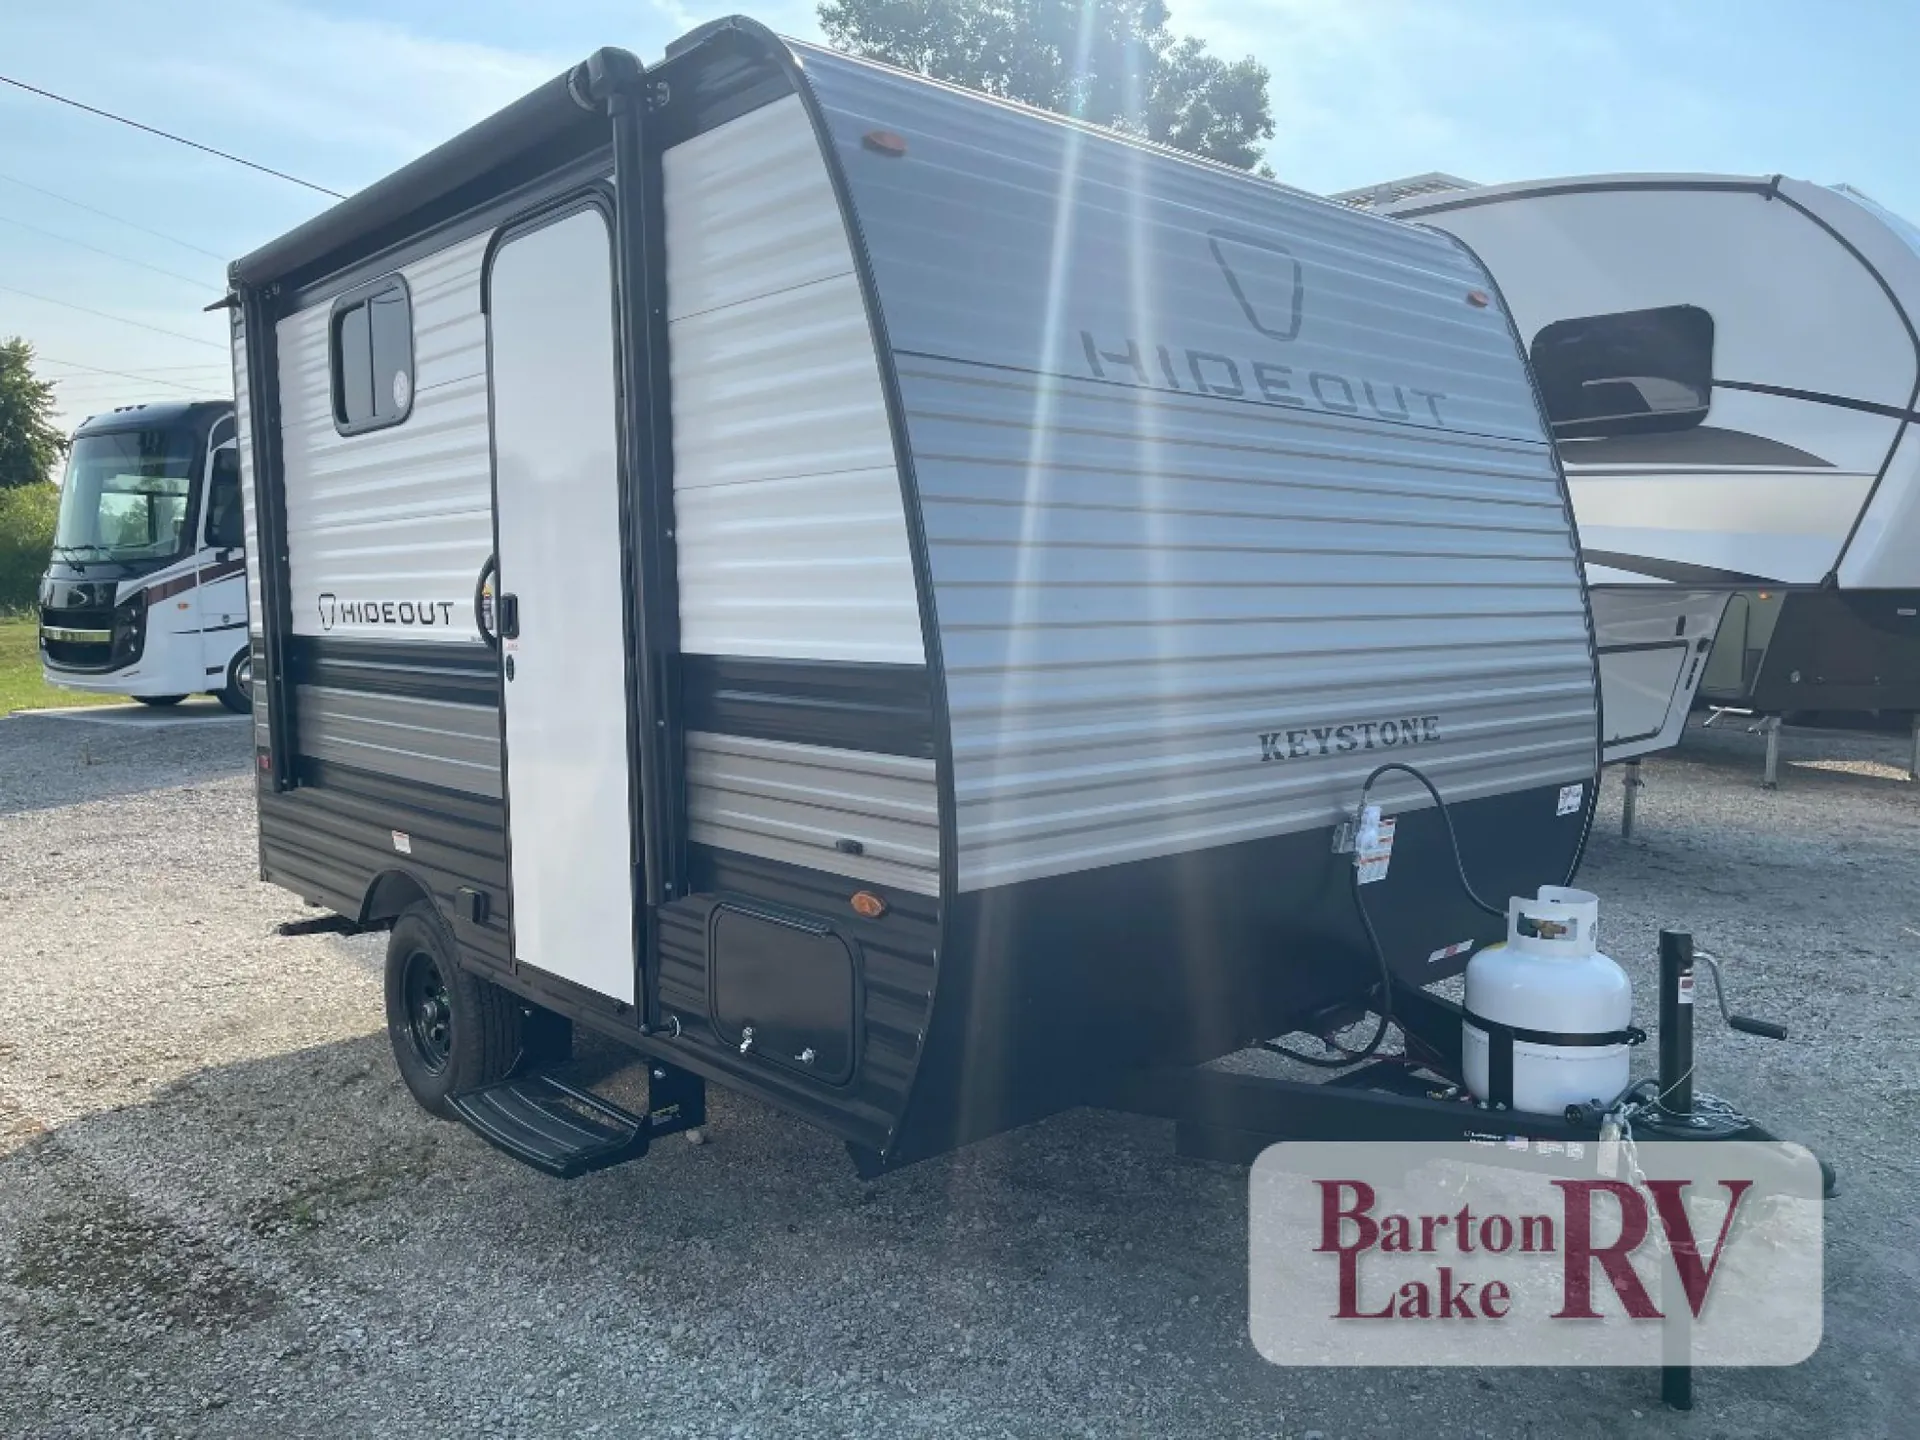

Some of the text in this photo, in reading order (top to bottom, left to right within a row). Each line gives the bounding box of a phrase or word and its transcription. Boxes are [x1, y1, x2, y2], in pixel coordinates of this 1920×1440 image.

[1080, 331, 1446, 425] HIDEOUT
[341, 602, 454, 625] HIDEOUT
[1259, 716, 1441, 761] KEYSTONE
